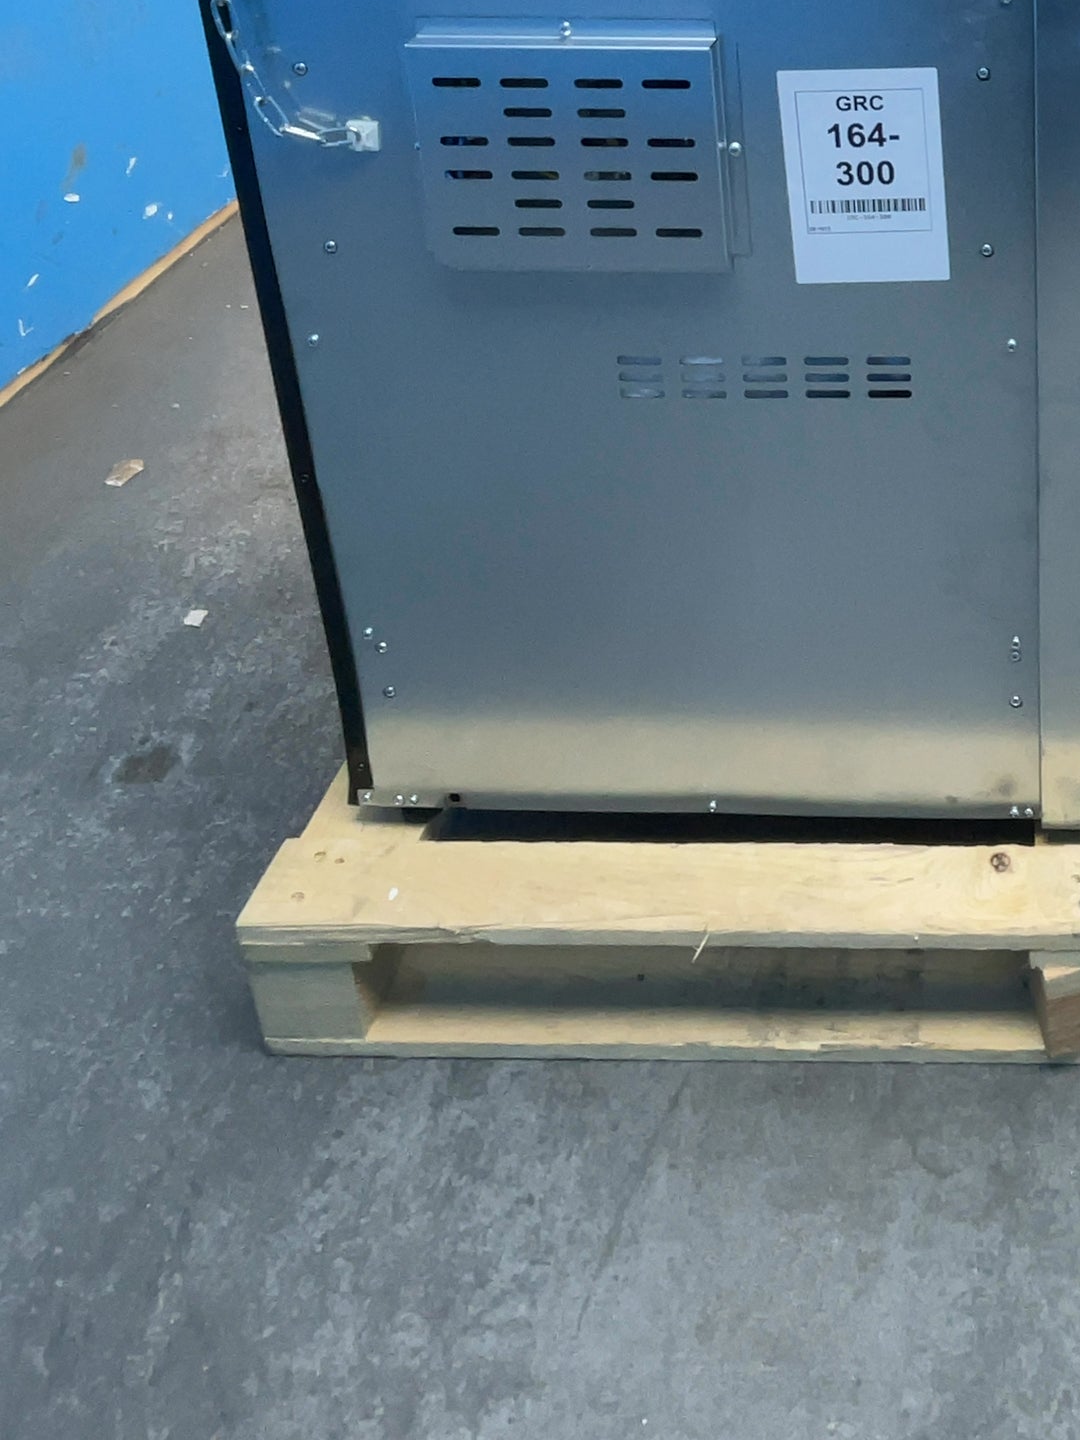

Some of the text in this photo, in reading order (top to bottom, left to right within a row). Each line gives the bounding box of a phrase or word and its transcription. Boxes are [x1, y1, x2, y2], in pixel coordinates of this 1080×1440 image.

[836, 95, 884, 111] GRC
[827, 122, 900, 148] 164-
[836, 160, 895, 186] 300
